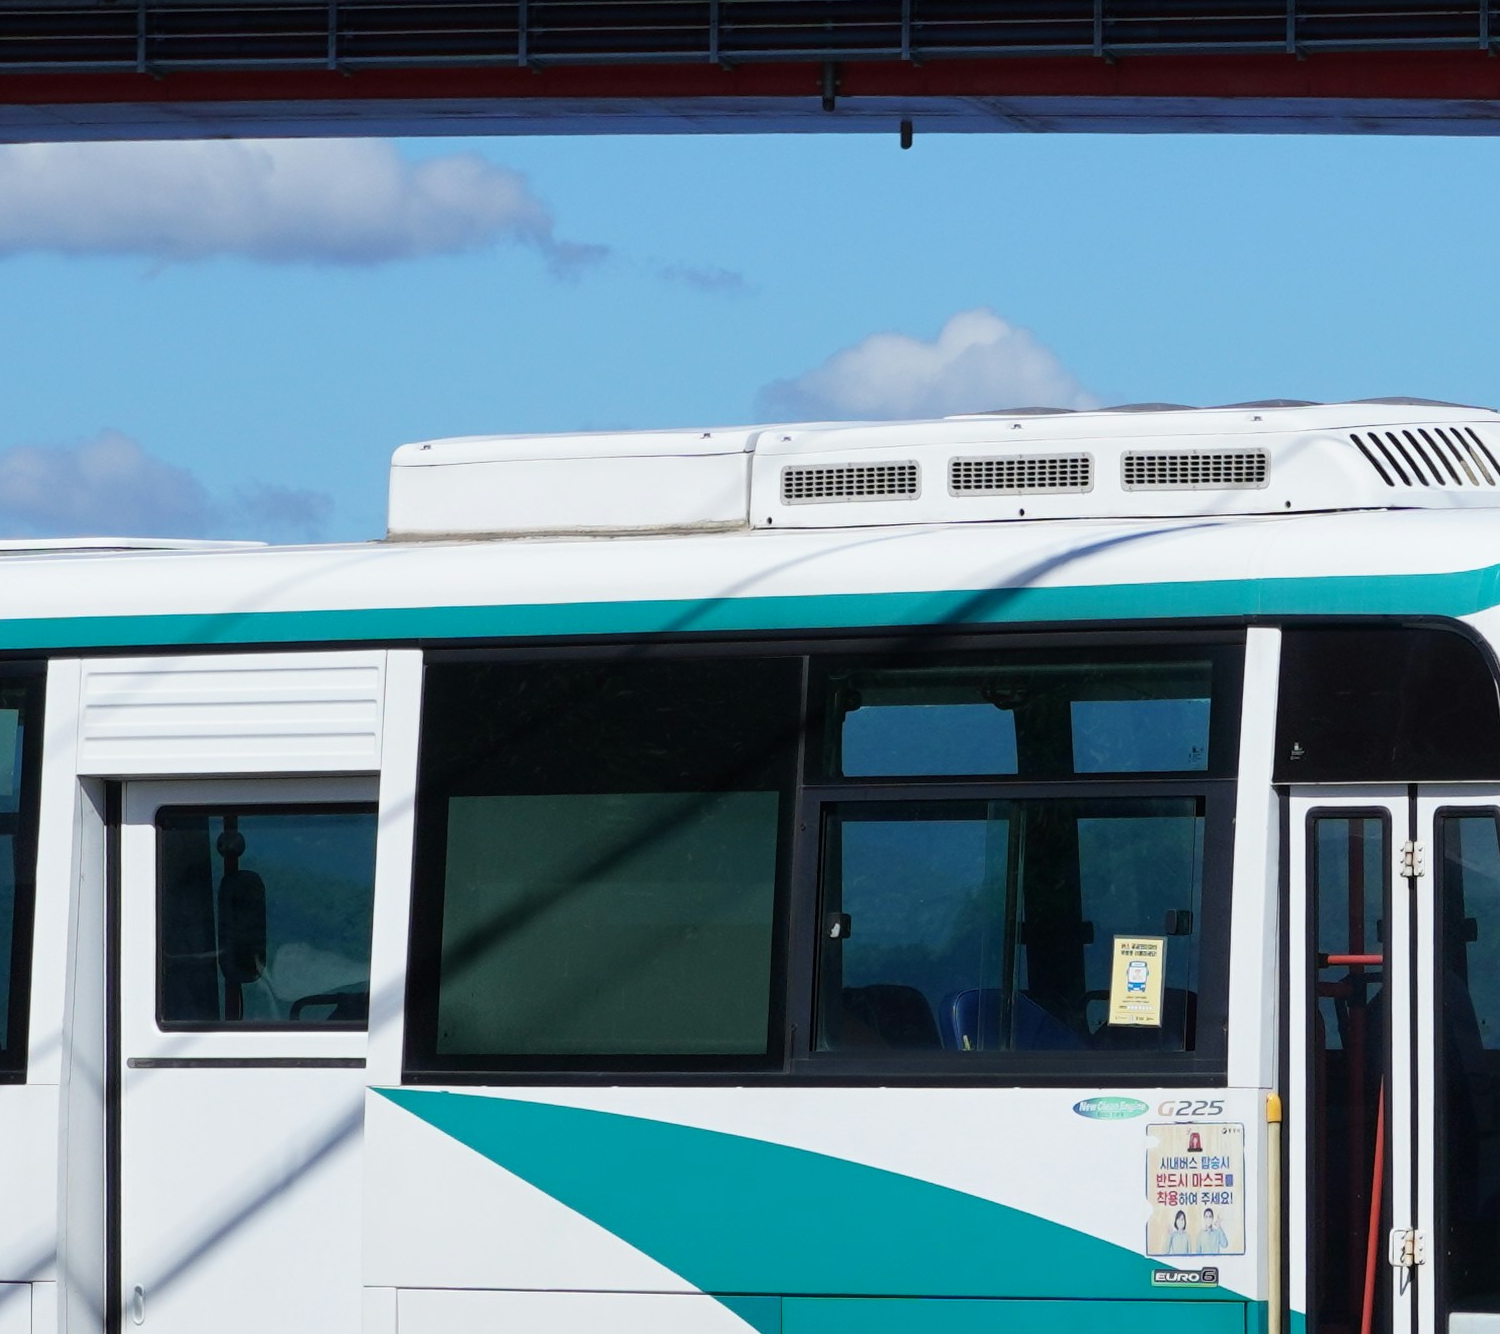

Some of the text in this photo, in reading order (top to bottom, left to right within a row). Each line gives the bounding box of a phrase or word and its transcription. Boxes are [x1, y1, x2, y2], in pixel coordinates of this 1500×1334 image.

[1157, 1100, 1225, 1117] G225
[1160, 1156, 1230, 1170] 시내버스 탑승시
[1156, 1173, 1188, 1188] 반드시
[1156, 1190, 1233, 1206] 착용하여 주세요!
